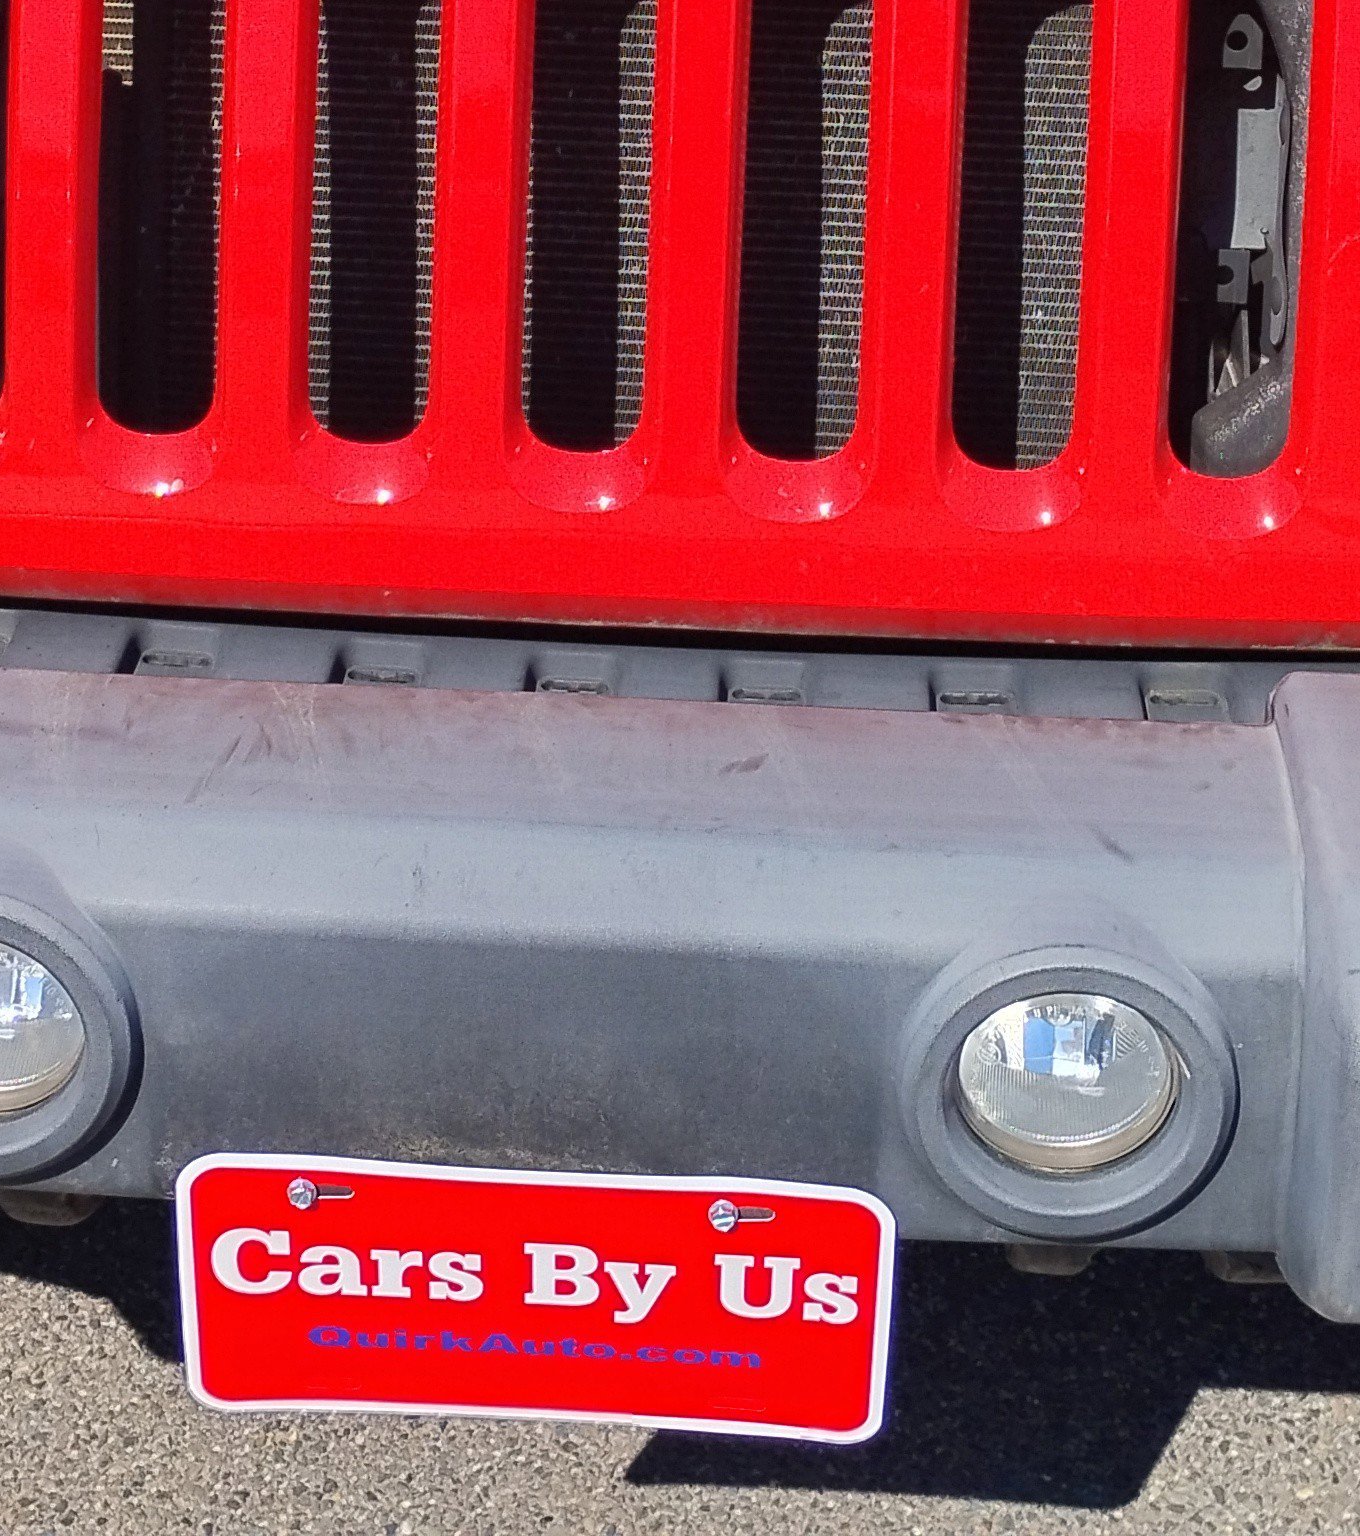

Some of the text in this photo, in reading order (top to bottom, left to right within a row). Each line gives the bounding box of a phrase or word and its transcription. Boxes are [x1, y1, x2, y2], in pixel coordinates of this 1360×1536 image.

[210, 1228, 859, 1324] Cars By Us
[307, 1325, 761, 1368] QuirkAuto.com
